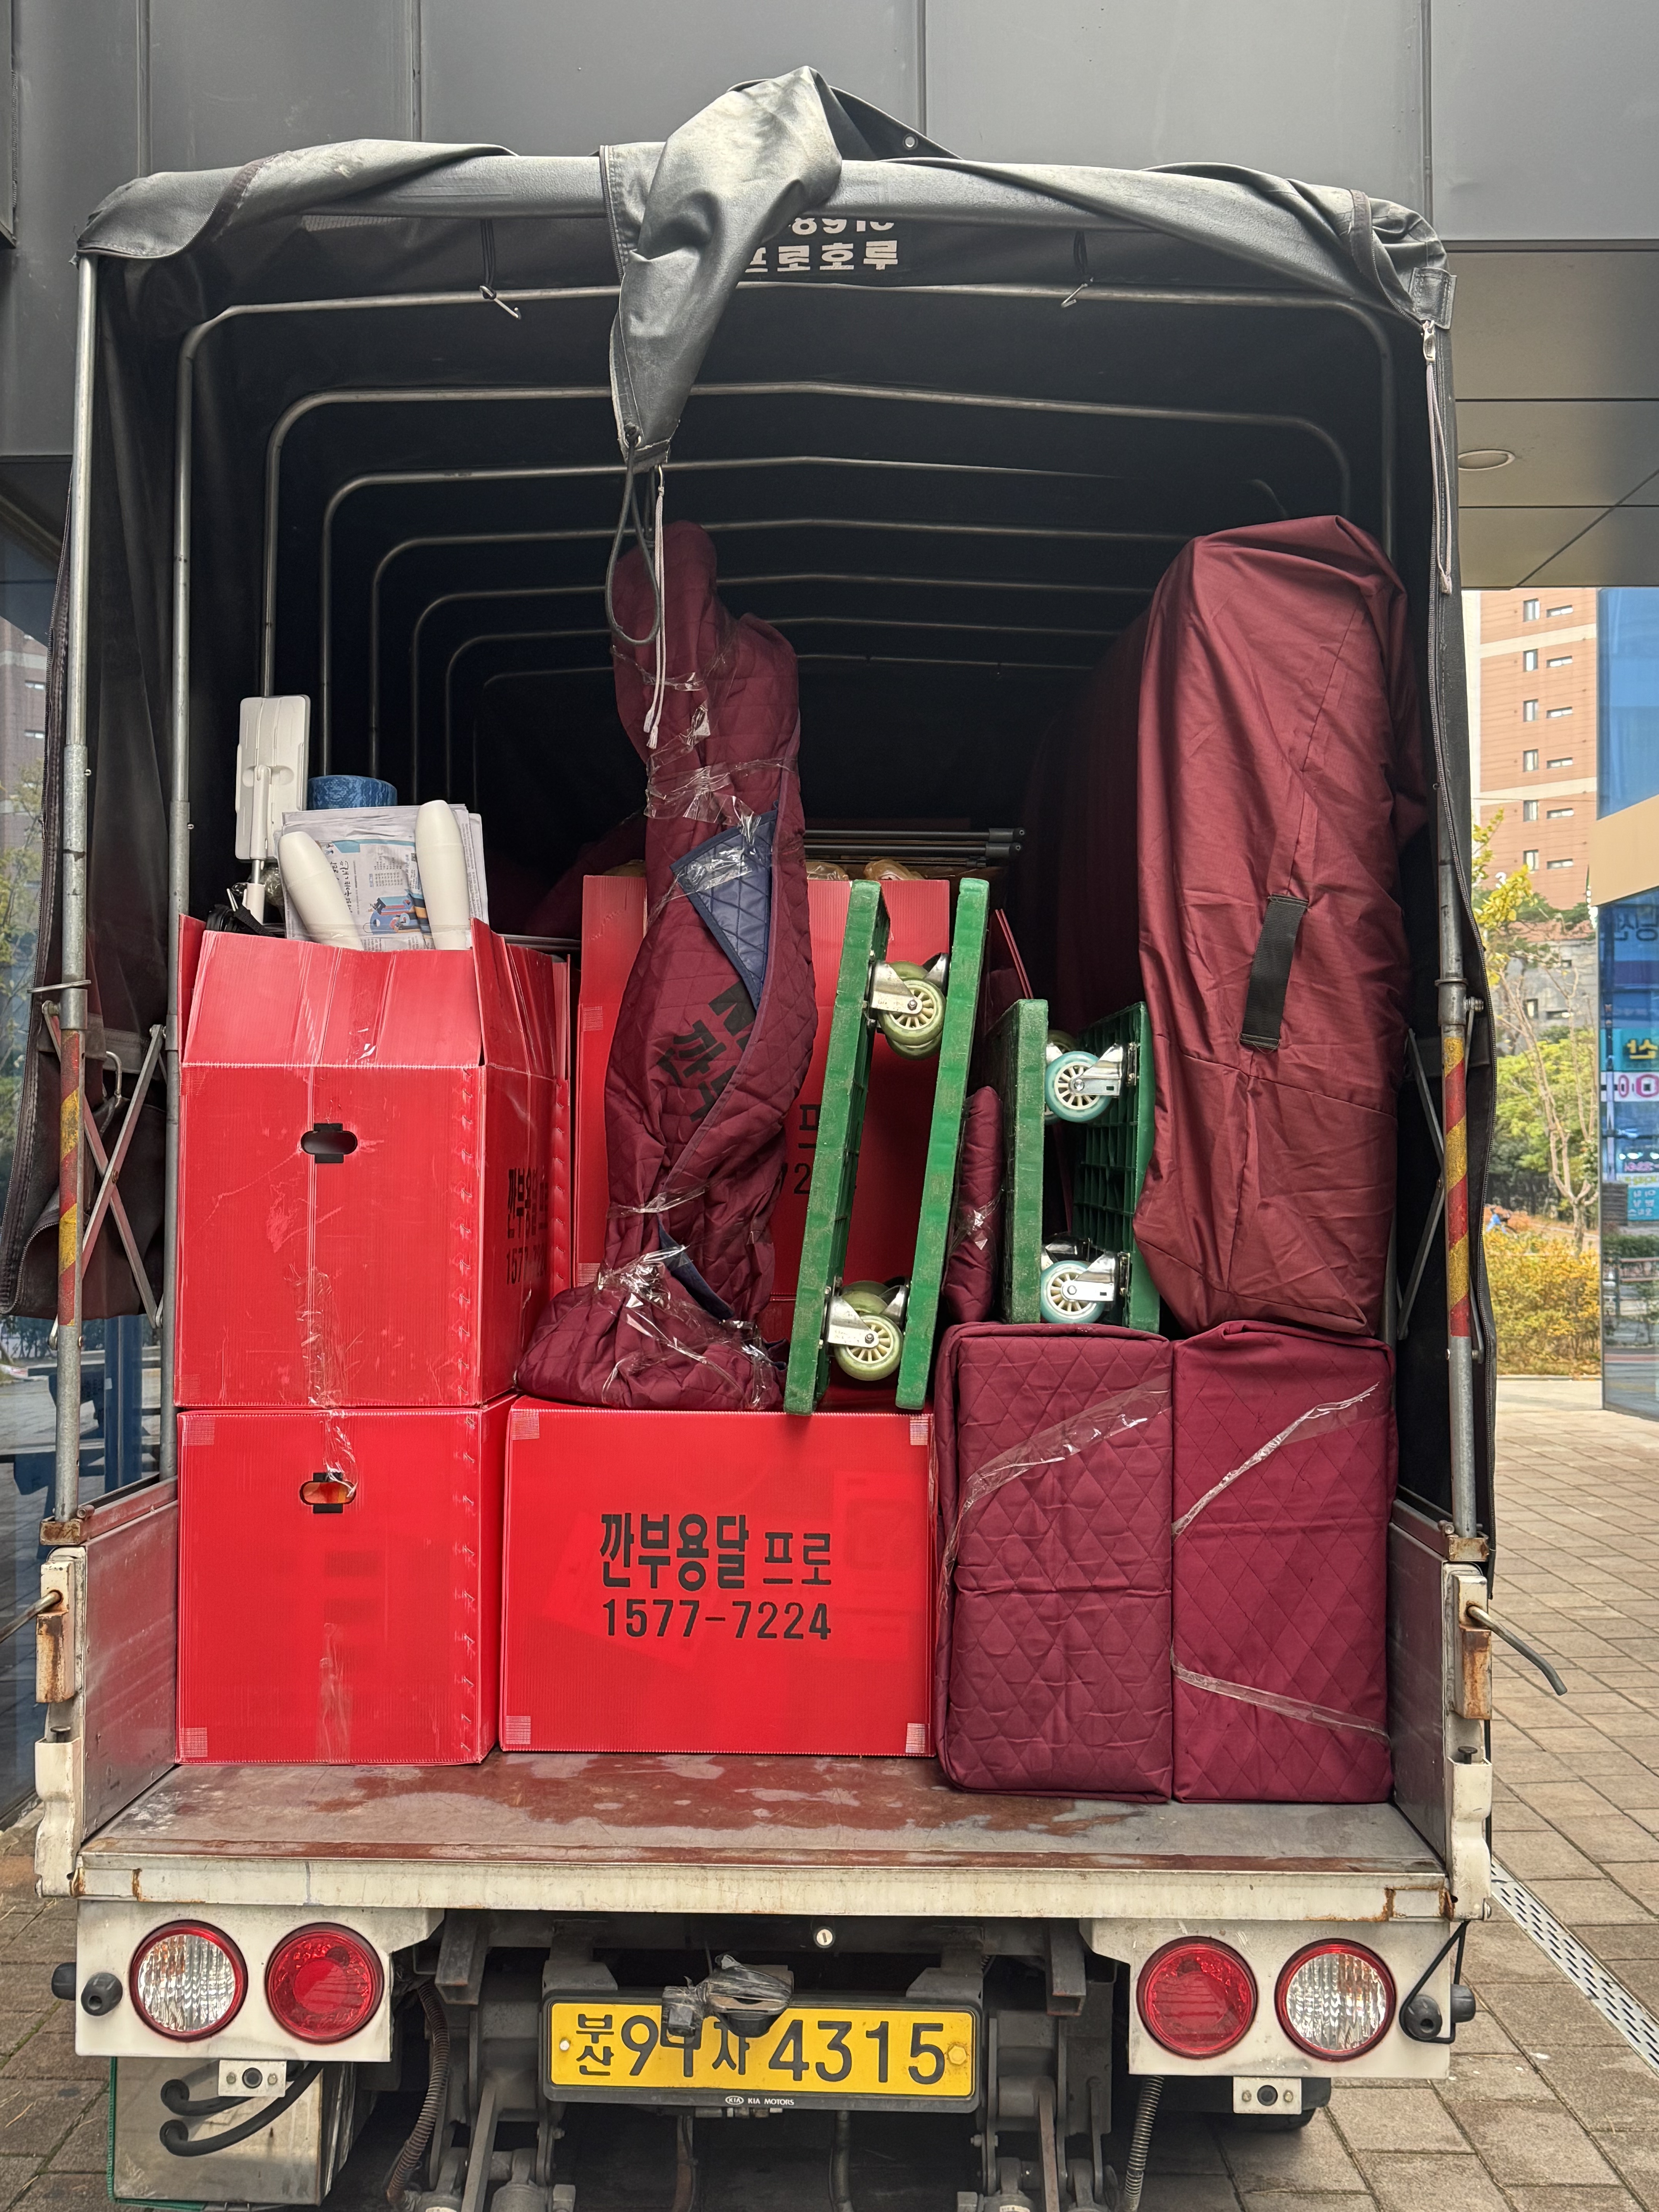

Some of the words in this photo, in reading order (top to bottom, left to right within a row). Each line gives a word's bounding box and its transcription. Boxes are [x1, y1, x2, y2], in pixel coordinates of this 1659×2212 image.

[599, 1513, 749, 1591] 깐부용달
[763, 1532, 831, 1585] 프로
[602, 1599, 831, 1640] 1577-7224
[576, 2014, 615, 2076] 부산
[768, 2019, 945, 2085] 4315
